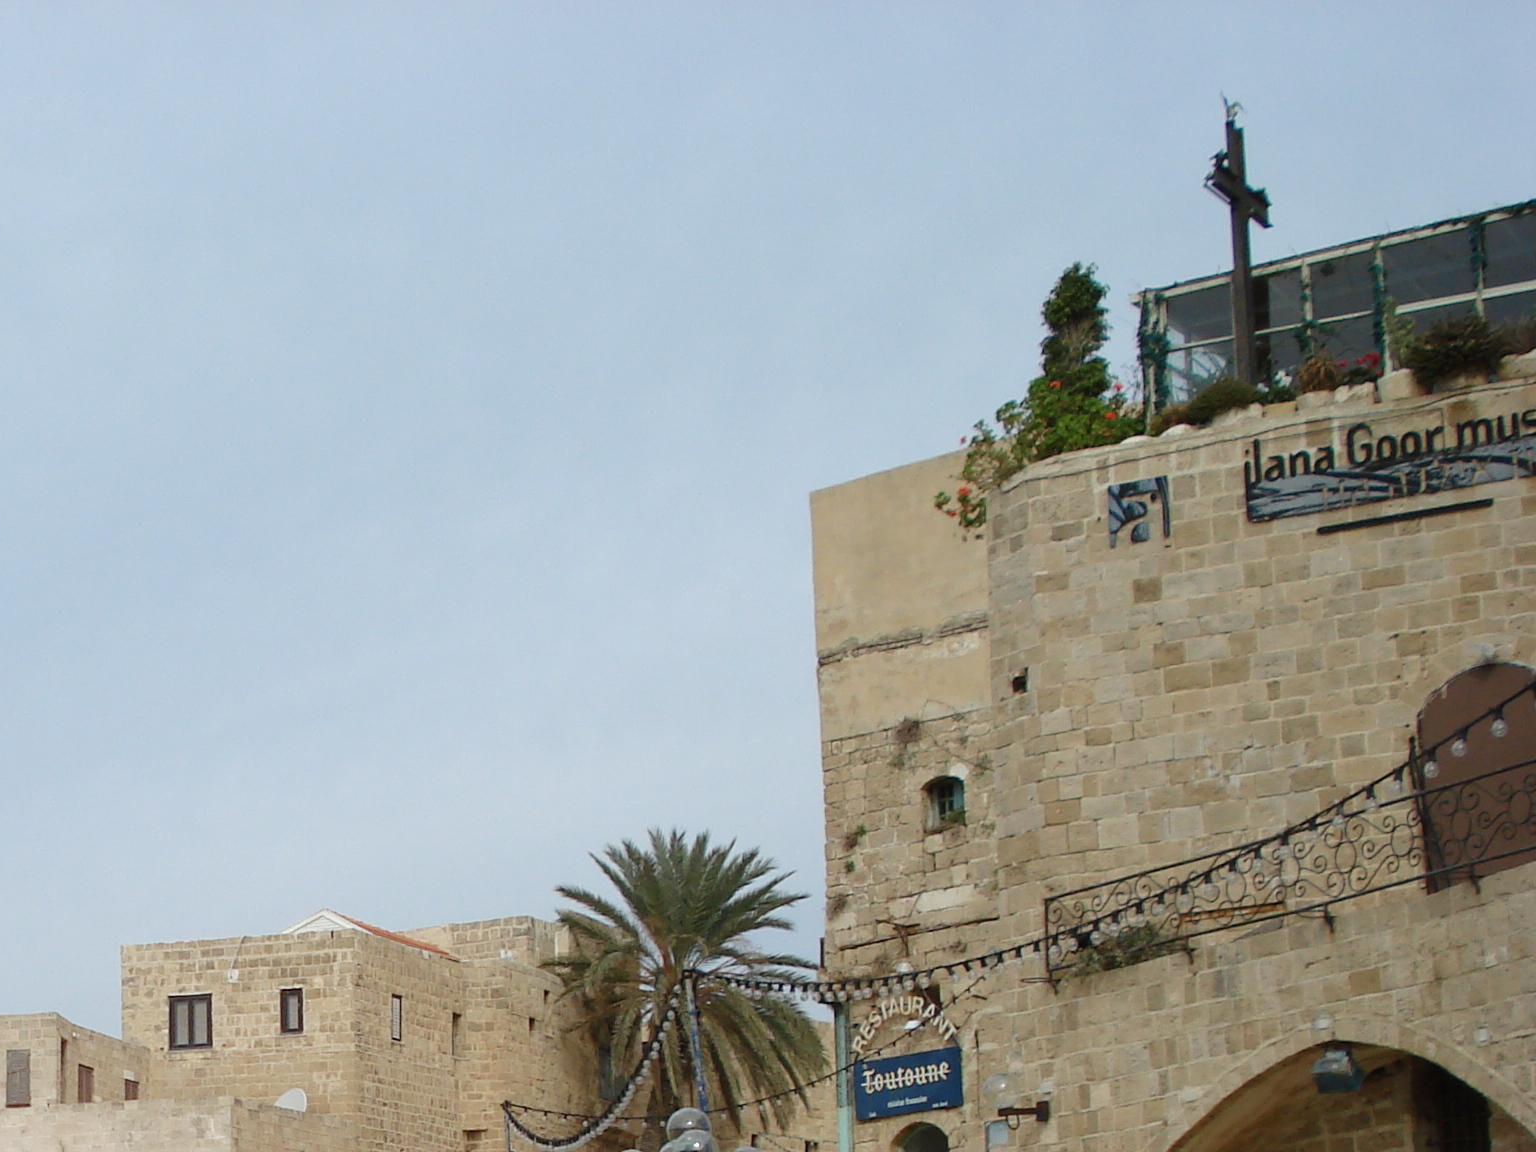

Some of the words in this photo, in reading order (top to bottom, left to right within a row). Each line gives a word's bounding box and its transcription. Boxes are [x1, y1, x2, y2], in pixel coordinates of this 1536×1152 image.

[1346, 421, 1446, 468] Goor
[852, 995, 958, 1055] RESTAURANT
[861, 1060, 952, 1095] Toutoune
